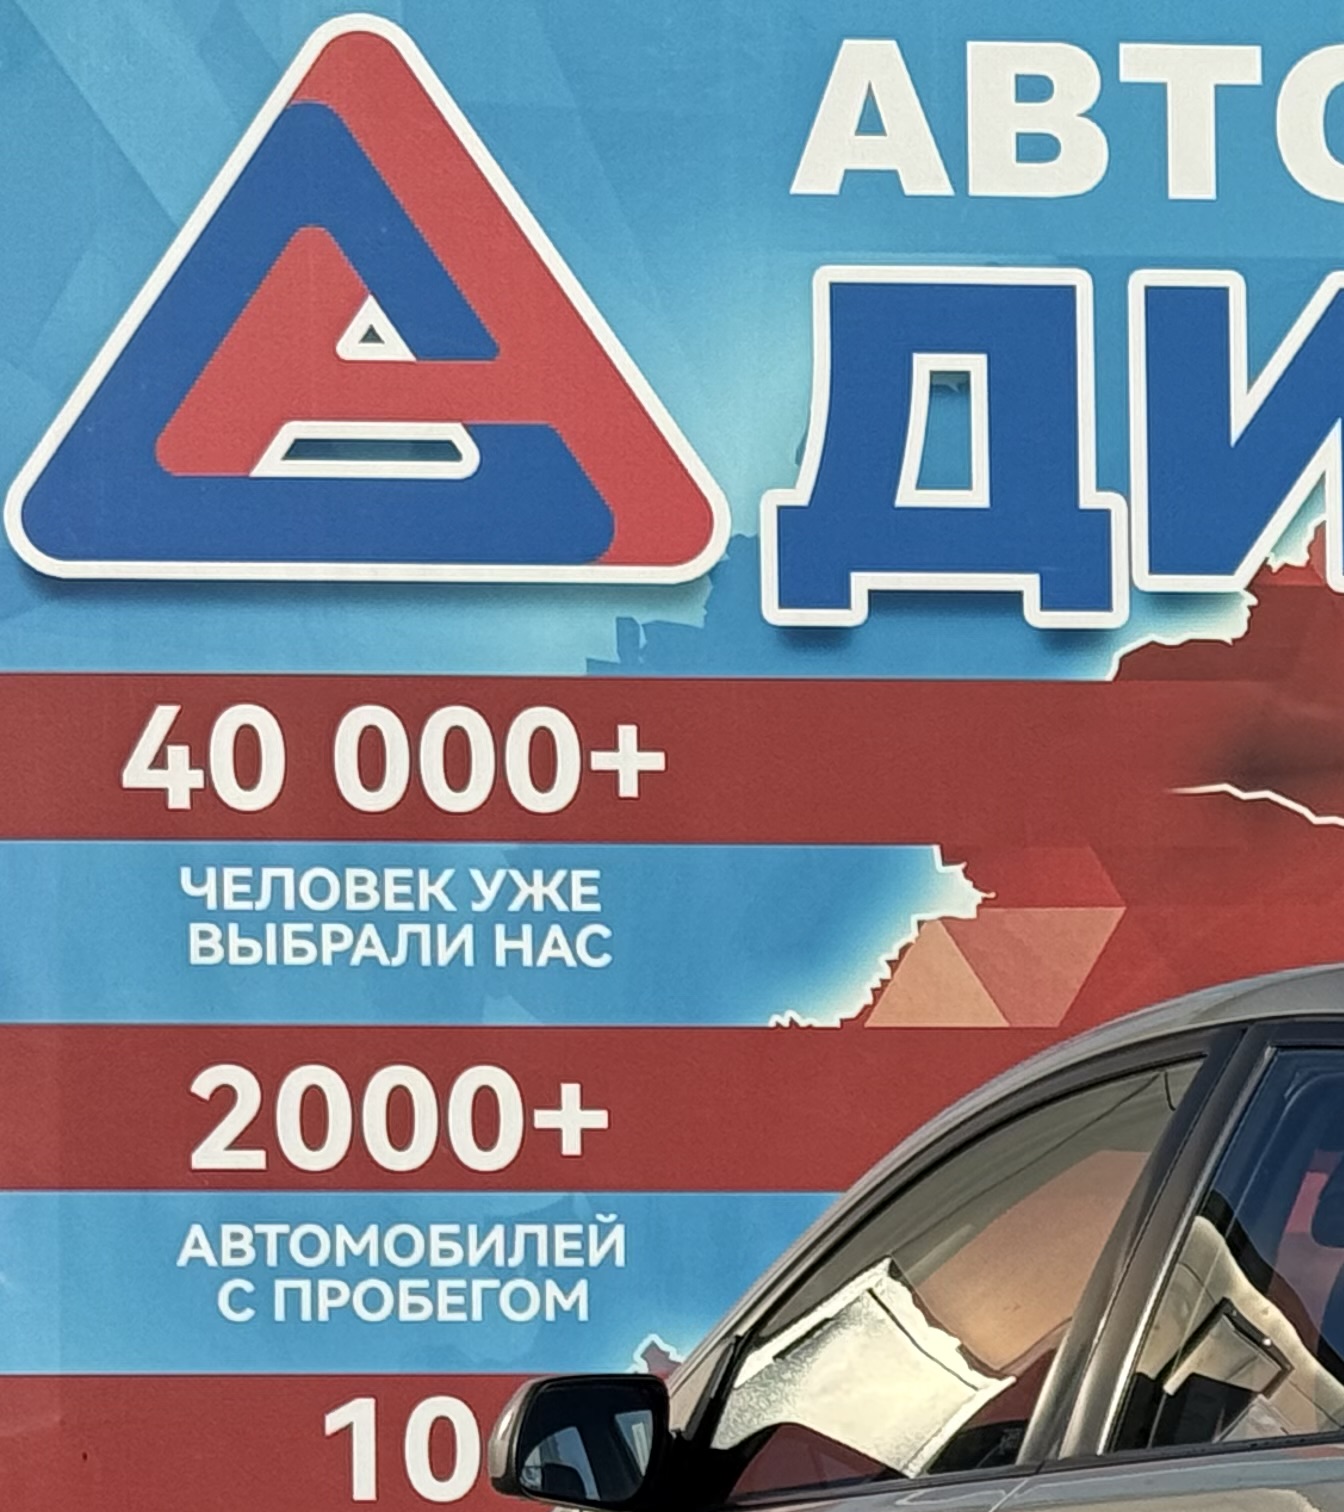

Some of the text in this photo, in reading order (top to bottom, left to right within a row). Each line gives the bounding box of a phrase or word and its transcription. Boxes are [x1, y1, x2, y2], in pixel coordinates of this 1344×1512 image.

[122, 703, 666, 813] 40 000+
[180, 866, 601, 912] ЧЕЛОВЕК УЖЕ
[189, 922, 612, 968] ВЫБРАЛИ НАС
[190, 1064, 609, 1172] 2000+
[177, 1213, 625, 1268] АВТОМОБИЛЕЙ
[217, 1279, 588, 1322] С ПРОБЕГОМ
